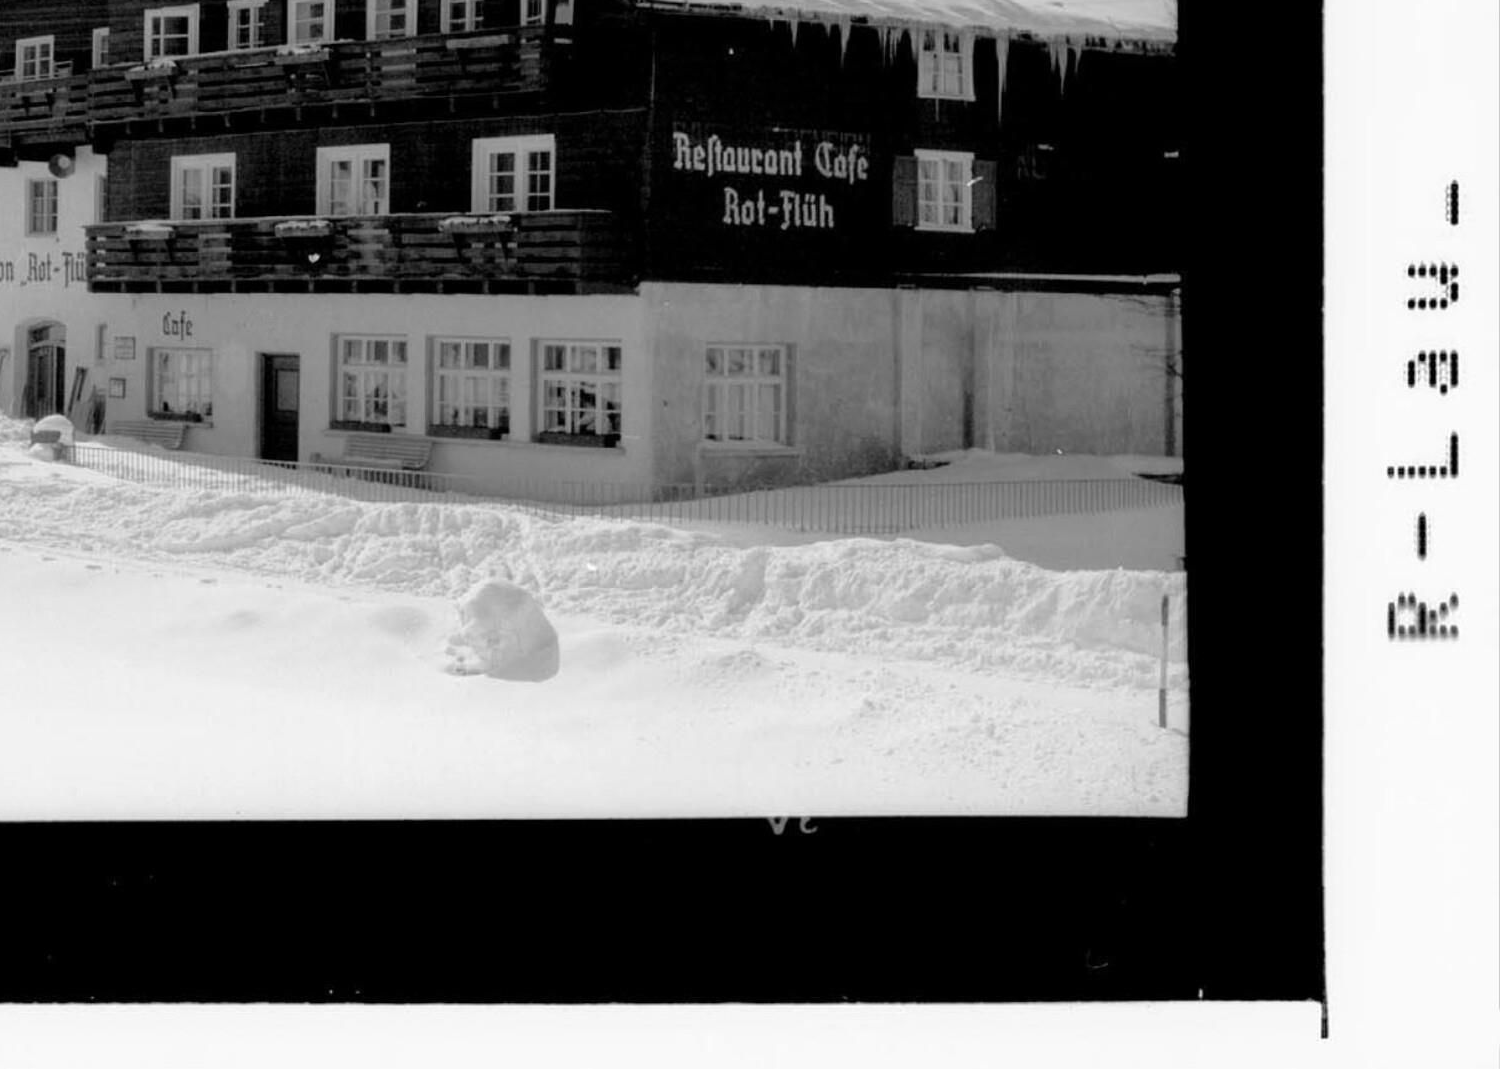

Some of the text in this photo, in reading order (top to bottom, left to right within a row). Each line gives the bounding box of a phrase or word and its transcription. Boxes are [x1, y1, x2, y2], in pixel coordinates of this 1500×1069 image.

[672, 131, 869, 185] Restaurant Cafe
[722, 186, 835, 231] Rot-Flüh
[162, 310, 193, 342] Cafe
